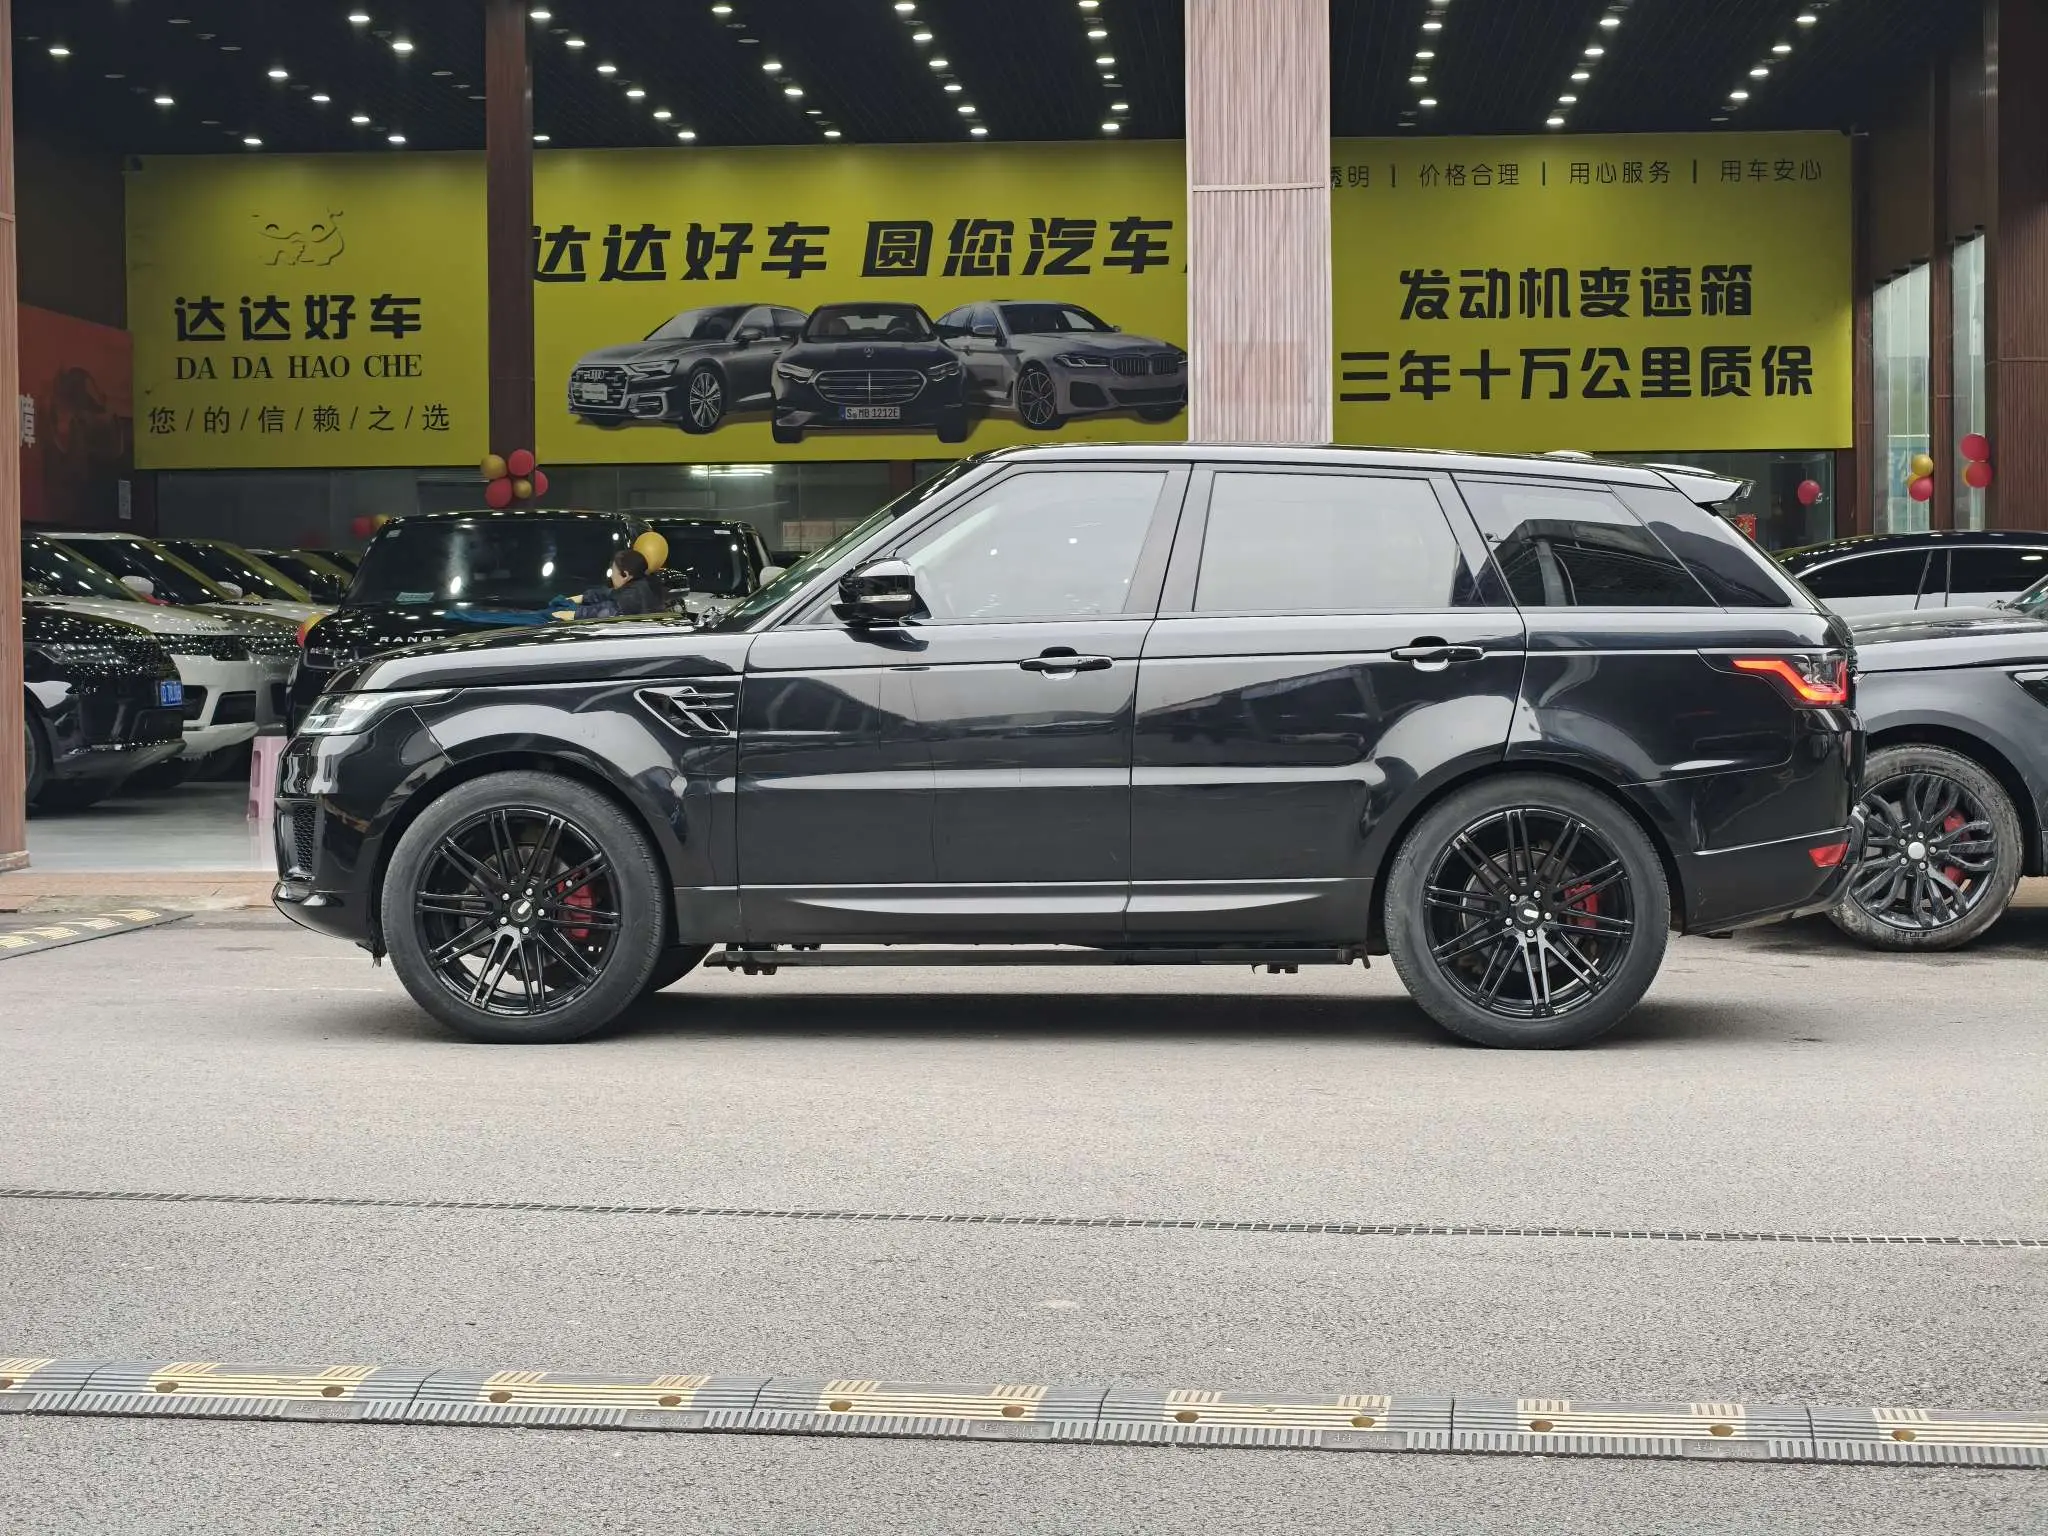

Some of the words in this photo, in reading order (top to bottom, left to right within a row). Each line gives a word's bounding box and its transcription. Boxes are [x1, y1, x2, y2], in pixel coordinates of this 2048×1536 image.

[1419, 161, 1520, 189] 价格合理
[1569, 159, 1671, 185] 用心服务
[1720, 157, 1822, 183] 用车安心
[532, 222, 831, 283] 达达好车
[859, 215, 1187, 278] 圆您汽车
[173, 293, 422, 342] 达达好车
[1399, 264, 1753, 321] 发动机变速箱
[174, 356, 218, 380] DA
[231, 356, 275, 380] DA
[287, 355, 351, 379] HAO
[363, 353, 423, 378] CHE
[1339, 344, 1814, 402] 三年十万公里质保
